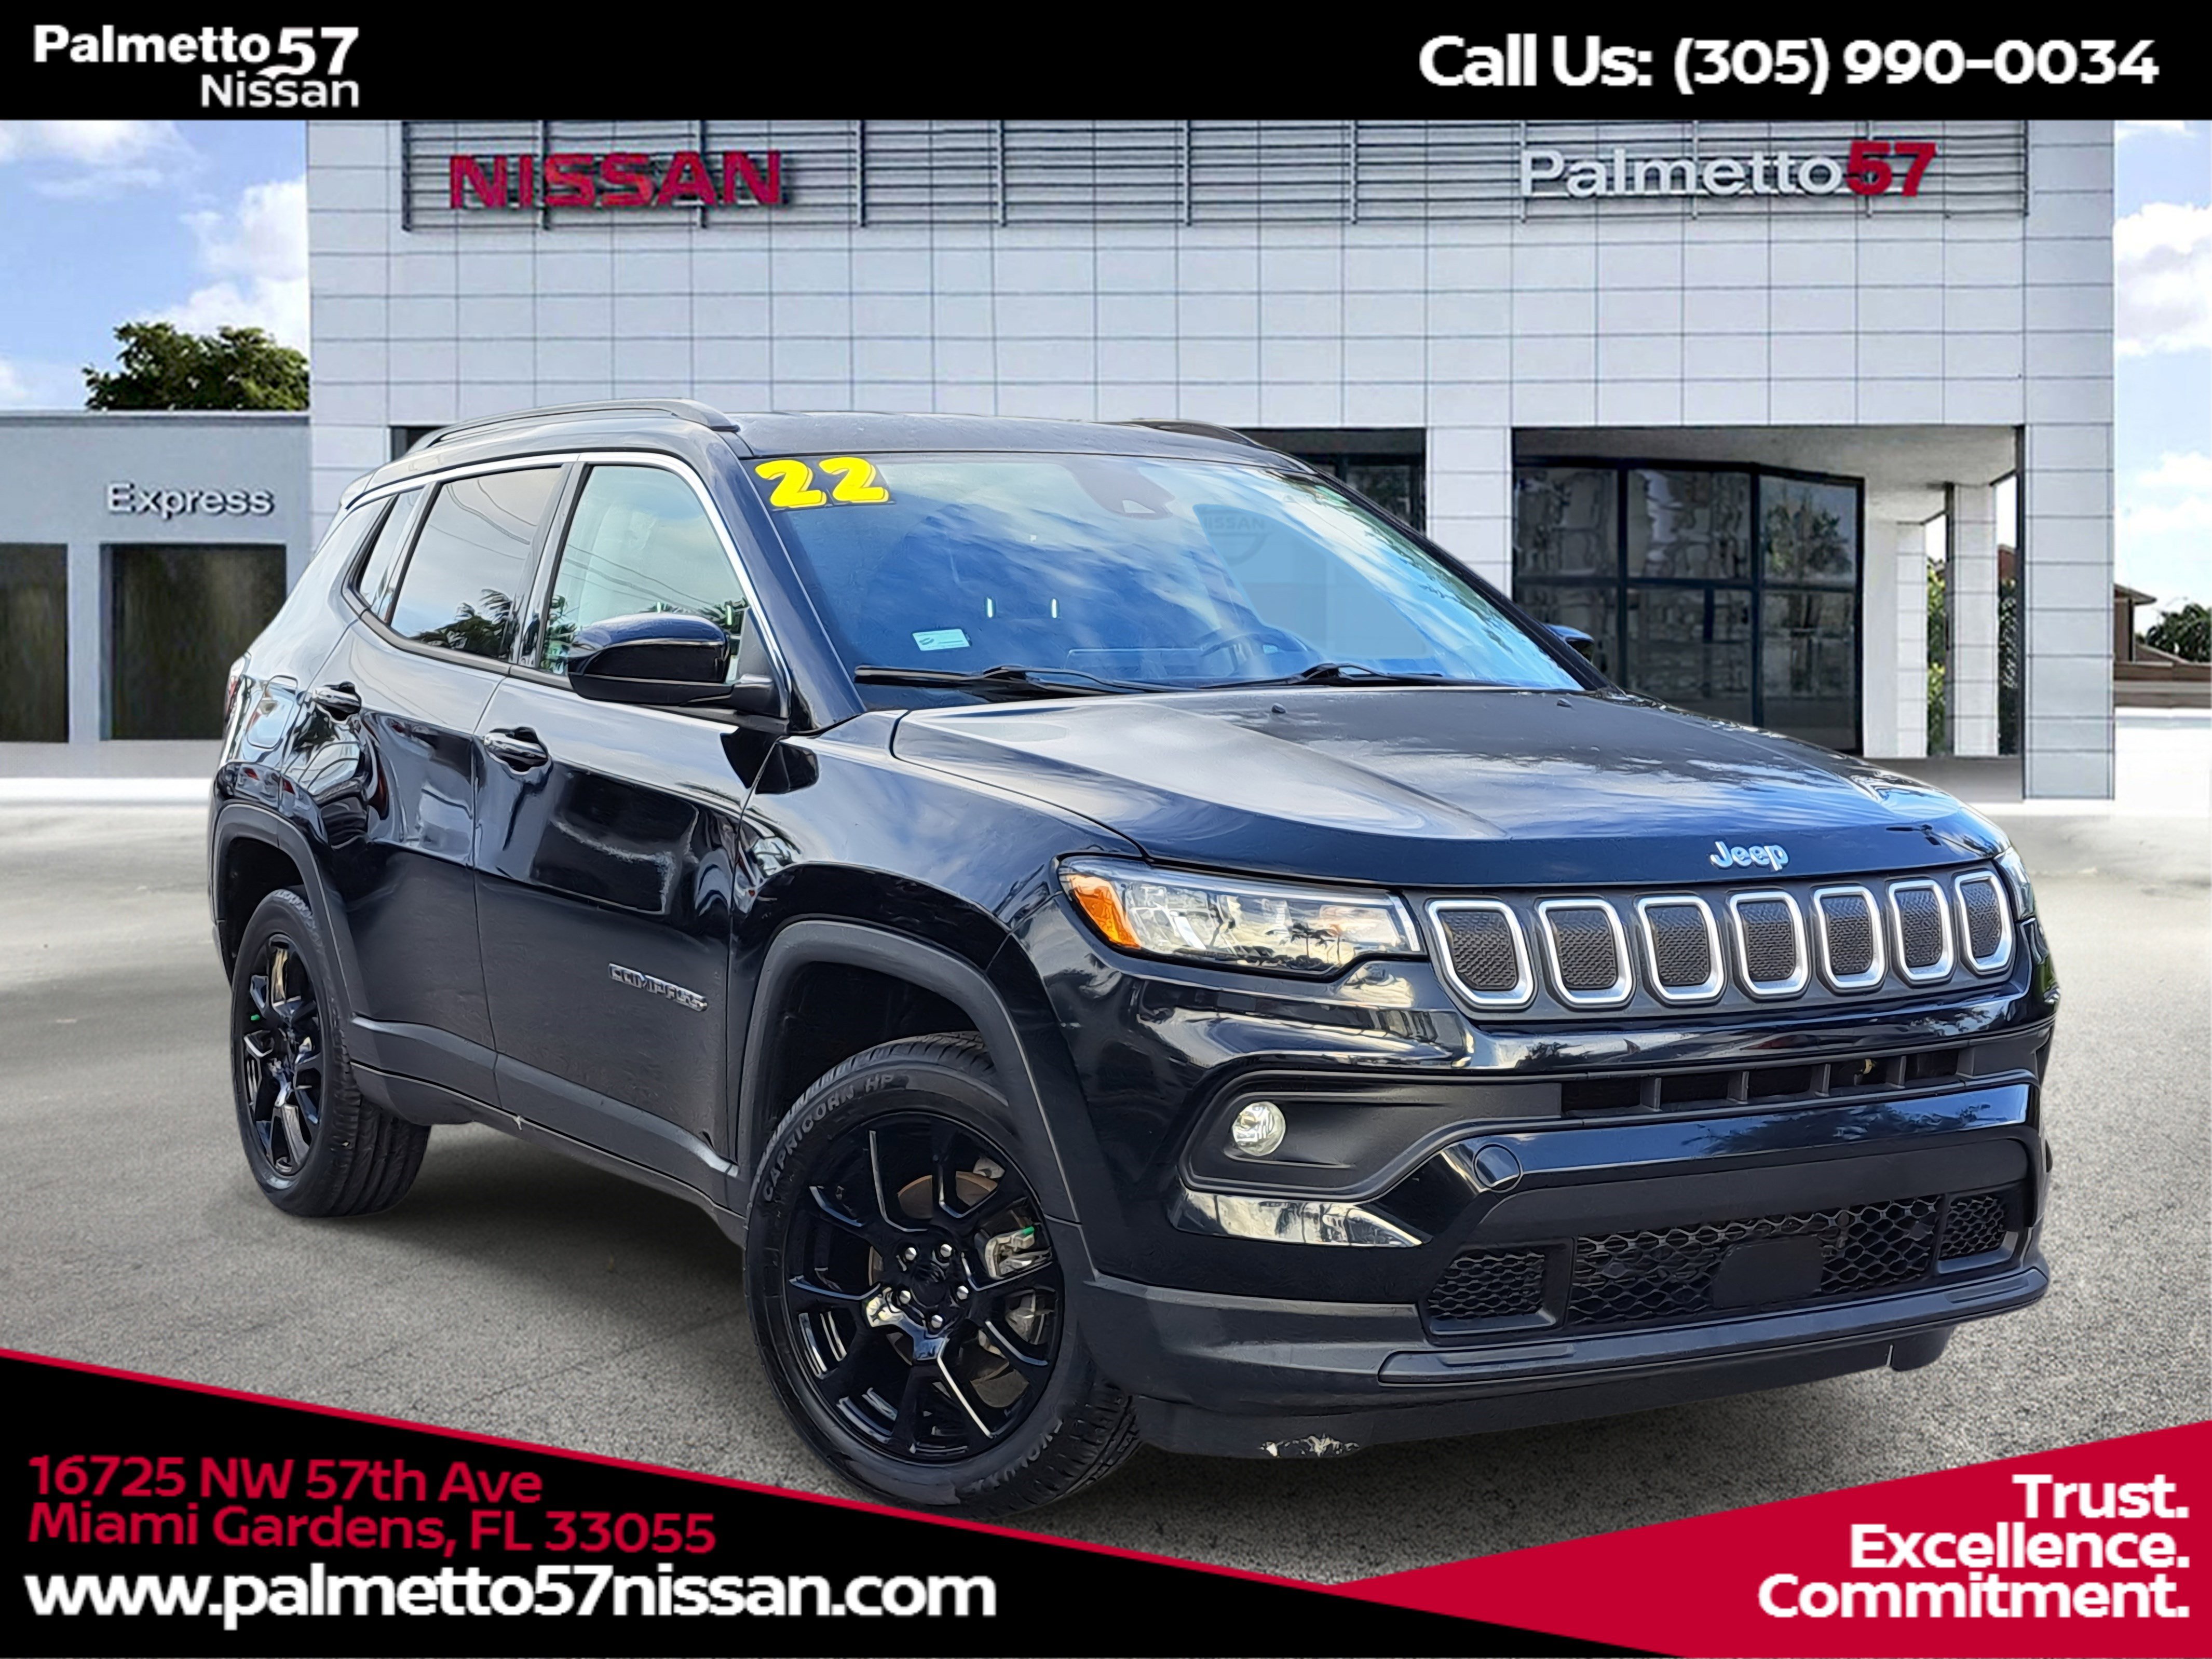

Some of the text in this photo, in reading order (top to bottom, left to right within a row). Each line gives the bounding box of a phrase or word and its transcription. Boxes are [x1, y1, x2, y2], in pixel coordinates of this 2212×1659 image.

[450, 151, 782, 209] NISSAN
[108, 483, 273, 519] Express
[755, 456, 889, 508] 22
[1710, 840, 1789, 872] Jeep
[608, 963, 709, 1012] COMPASS
